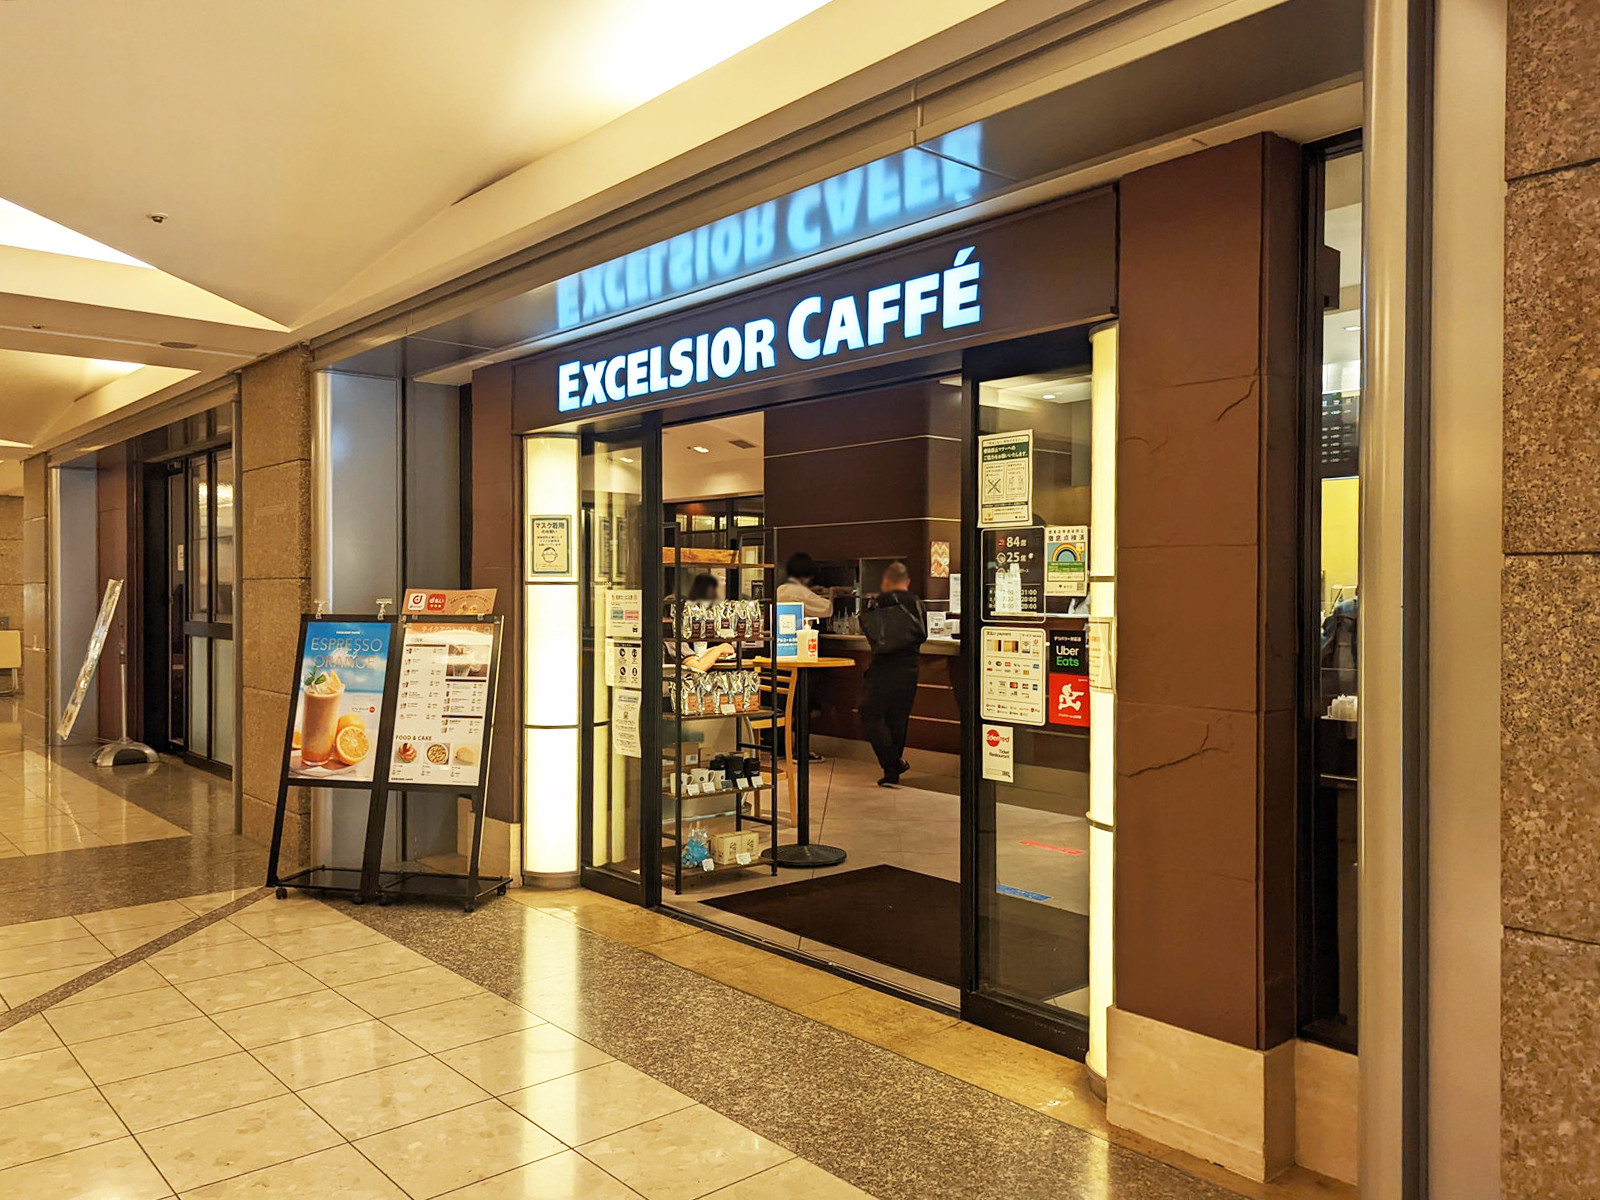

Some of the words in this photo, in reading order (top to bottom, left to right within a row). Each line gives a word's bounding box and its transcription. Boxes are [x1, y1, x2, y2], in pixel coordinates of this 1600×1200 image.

[557, 316, 776, 413] EXCELSIOR
[786, 245, 982, 361] CAFFÉ
[535, 522, 565, 530] マスク着用
[310, 637, 383, 652] ESPRESSO
[1055, 645, 1080, 656] Uber
[313, 653, 377, 669] ORANGE
[1056, 656, 1080, 667] Eats
